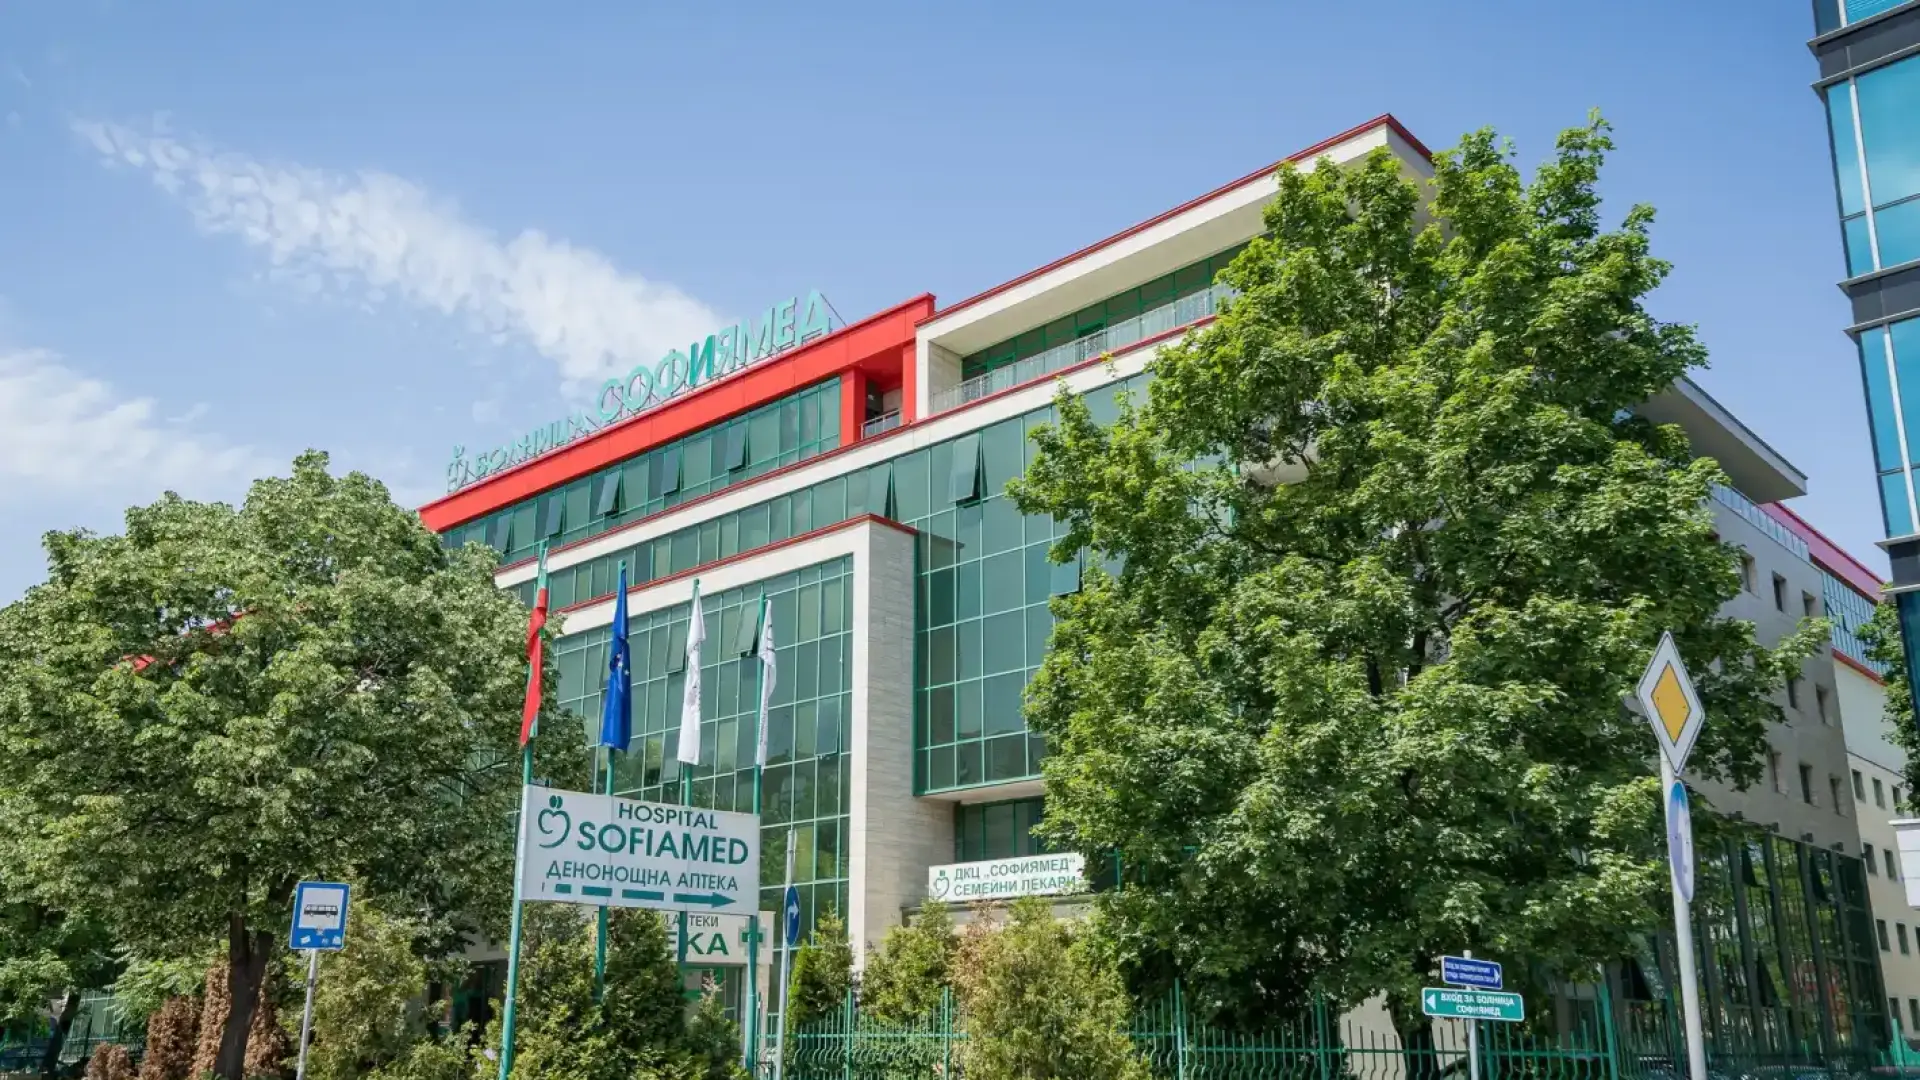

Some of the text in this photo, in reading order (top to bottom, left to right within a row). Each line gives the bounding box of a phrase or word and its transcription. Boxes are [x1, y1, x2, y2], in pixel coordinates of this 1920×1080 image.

[597, 288, 832, 423] СОФИЯМЕД
[618, 803, 718, 830] HOSPITAL
[577, 821, 749, 865] SOFIAMED
[546, 860, 739, 891] ДЕНОНОЩНА АПТЕКА
[954, 867, 980, 881] ДКЦ
[954, 875, 1076, 897] СЕМЕЙНИ ЛЕКАРИ
[671, 913, 719, 928] АТЕКИ
[1441, 992, 1463, 1004] ВХОД
[1464, 994, 1475, 1003] ЗА
